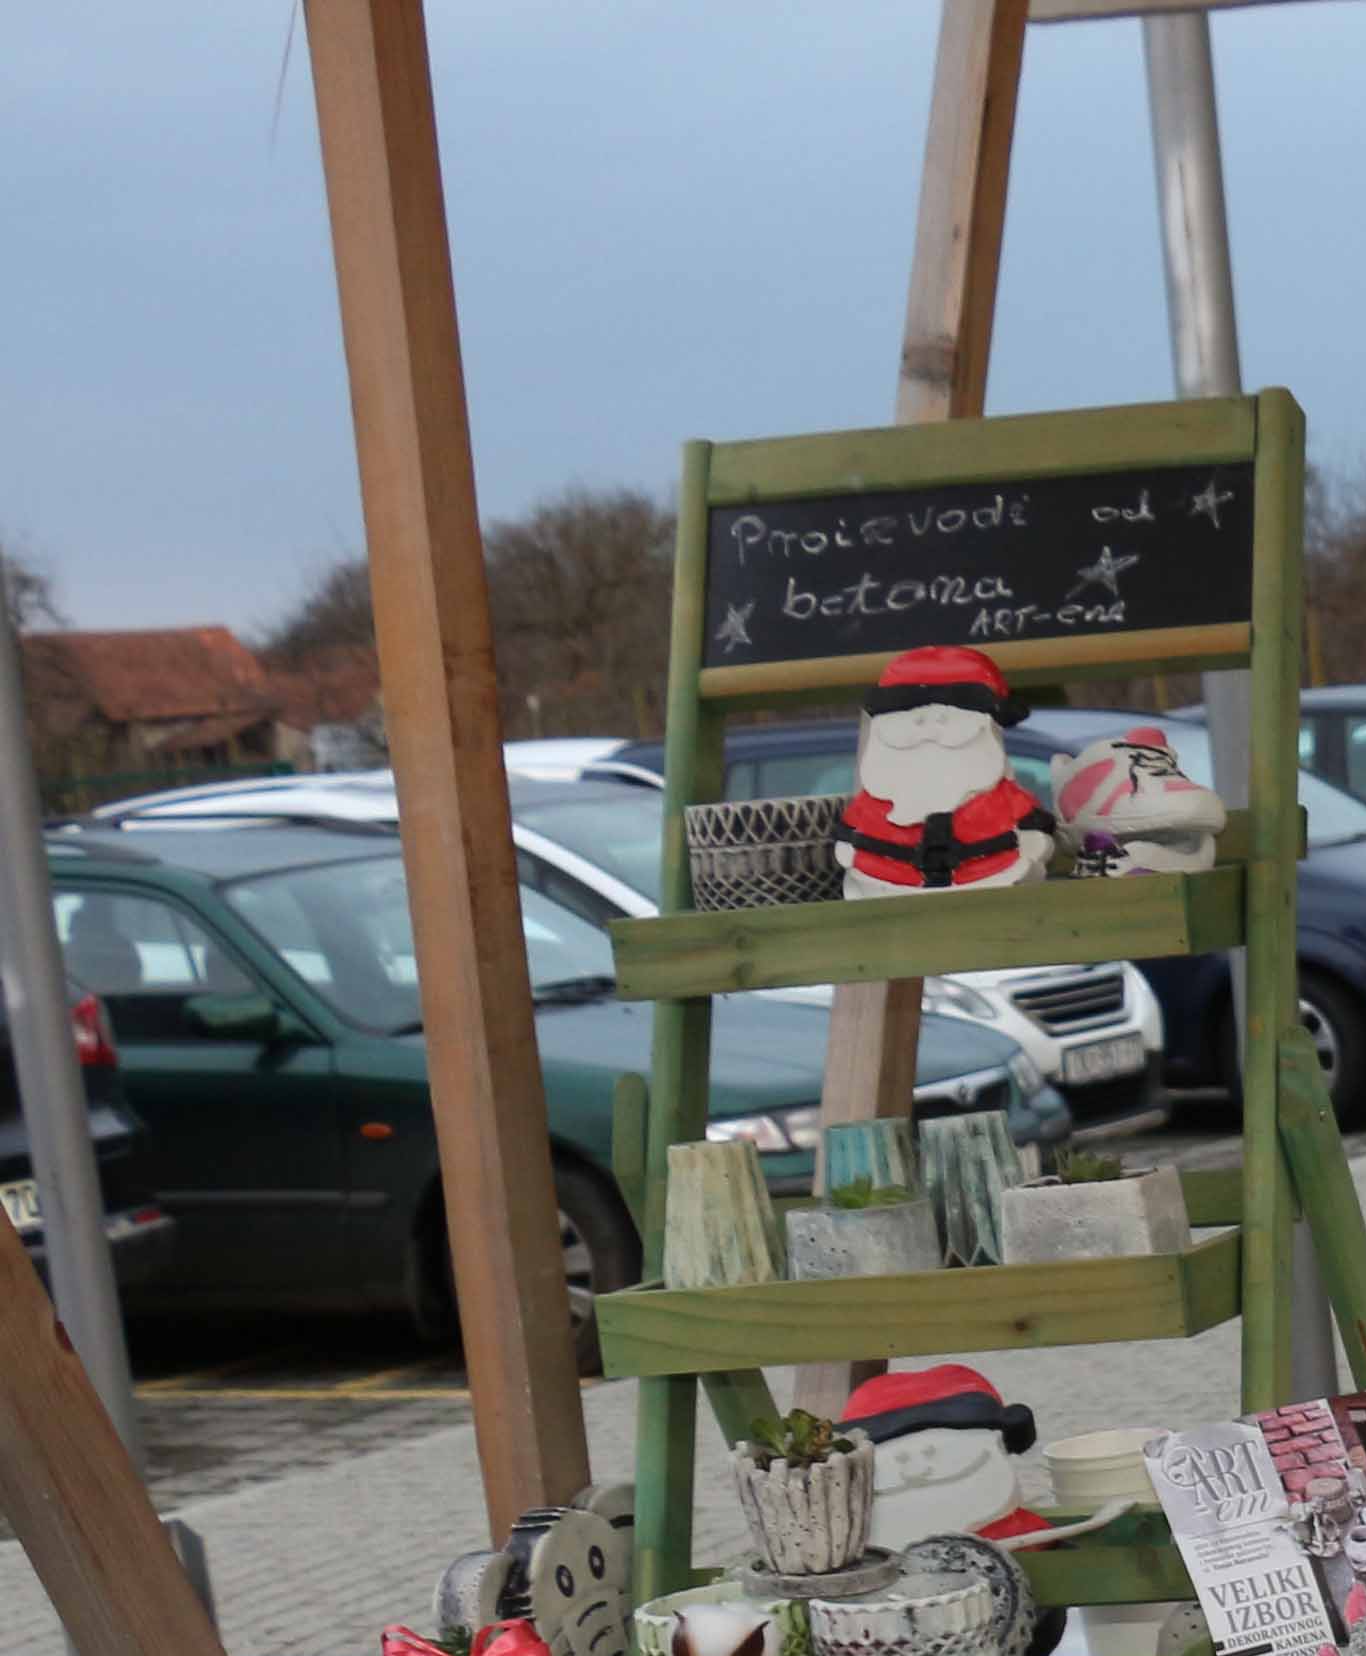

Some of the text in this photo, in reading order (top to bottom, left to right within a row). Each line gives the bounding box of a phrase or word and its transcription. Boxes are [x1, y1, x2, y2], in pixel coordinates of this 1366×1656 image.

[1091, 489, 1156, 522] od
[783, 572, 1013, 619] betona
[1162, 1440, 1266, 1507] ART
[1208, 1565, 1309, 1609] VELIKI
[1225, 1592, 1319, 1633] IZBOR
[1228, 1616, 1323, 1649] DEKORATIVNOG
[1272, 1630, 1328, 1651] KAMENA
